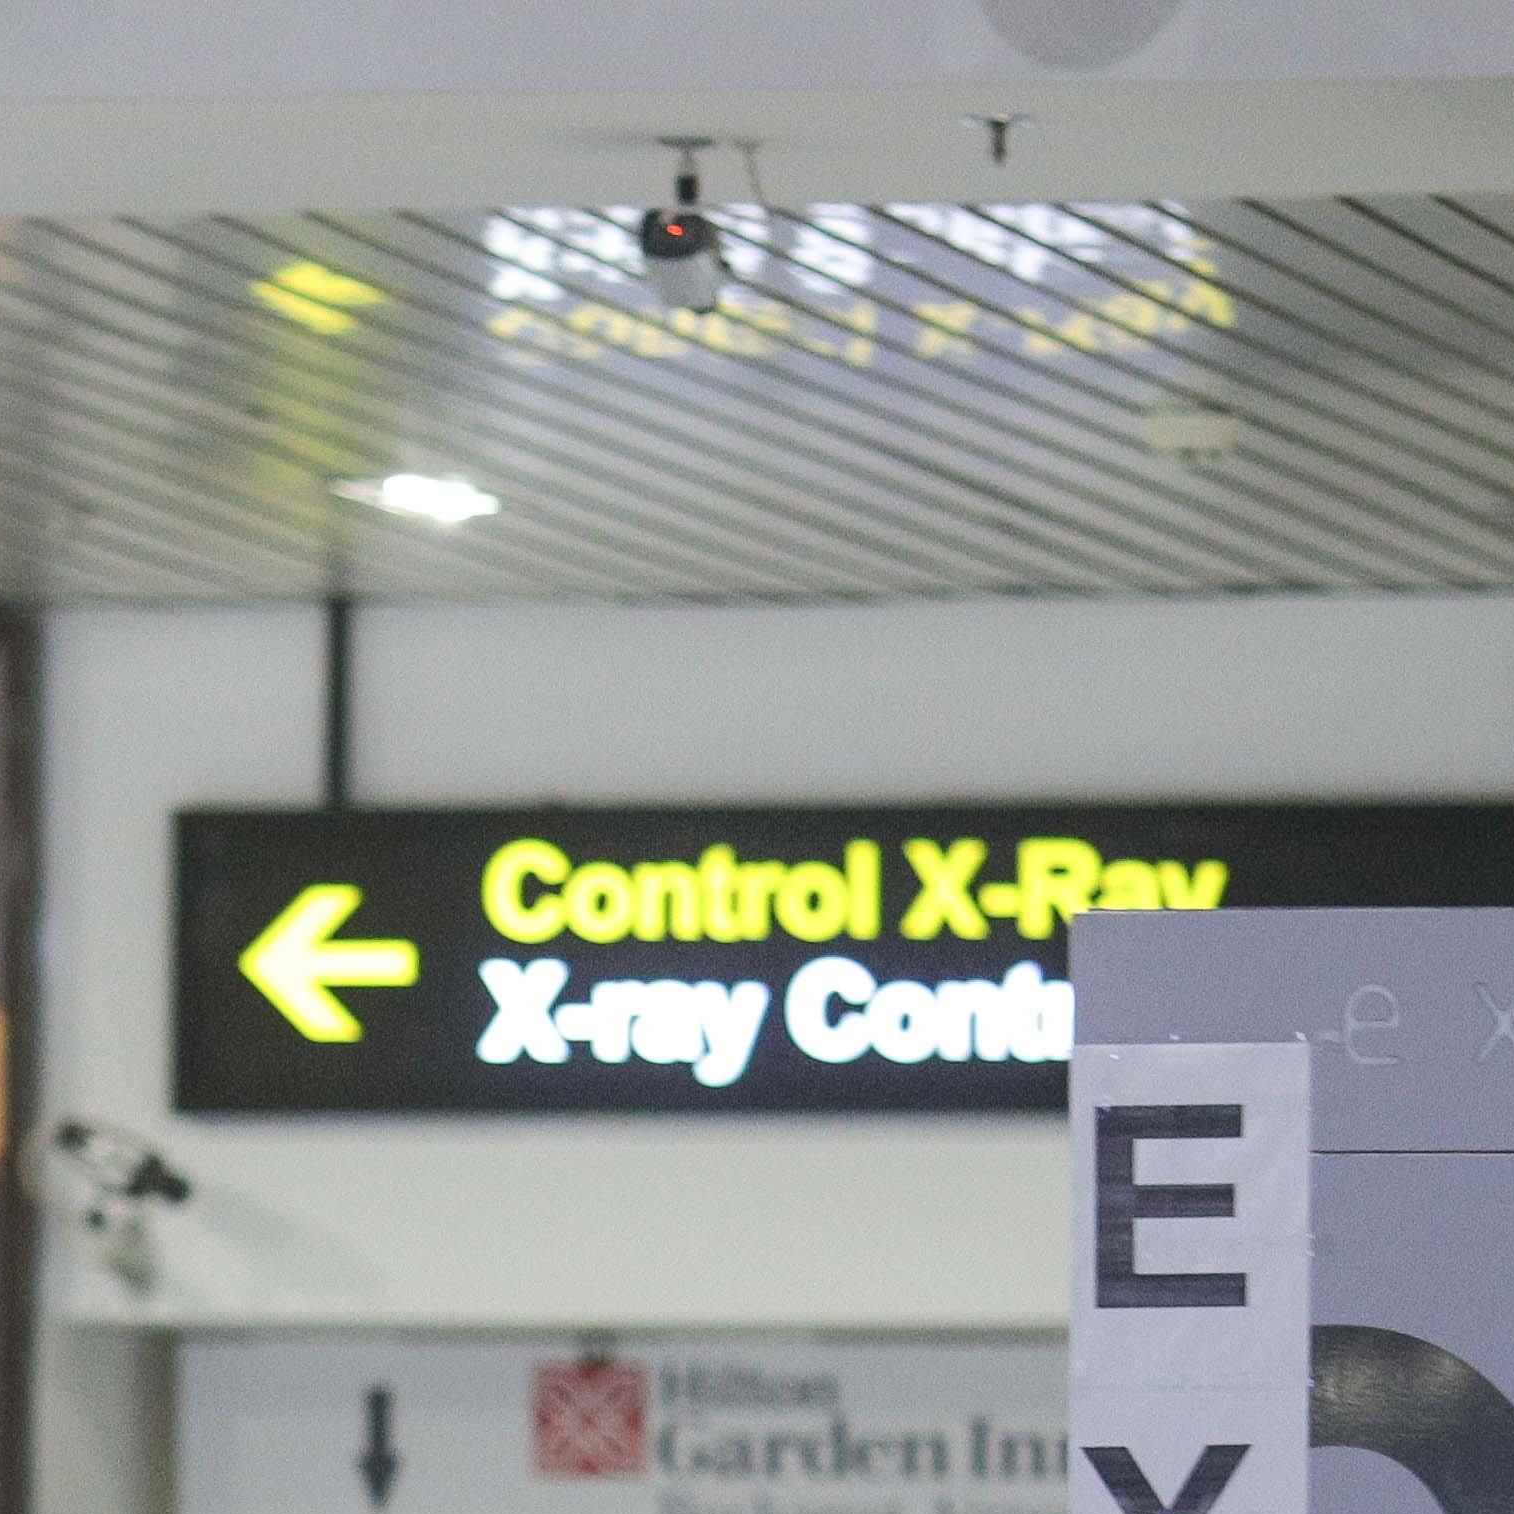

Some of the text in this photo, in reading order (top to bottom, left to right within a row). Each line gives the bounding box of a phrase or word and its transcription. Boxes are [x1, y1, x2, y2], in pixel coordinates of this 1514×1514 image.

[480, 837, 881, 944] Control
[475, 956, 770, 1088] X-ray
[657, 1410, 950, 1480] Garden
